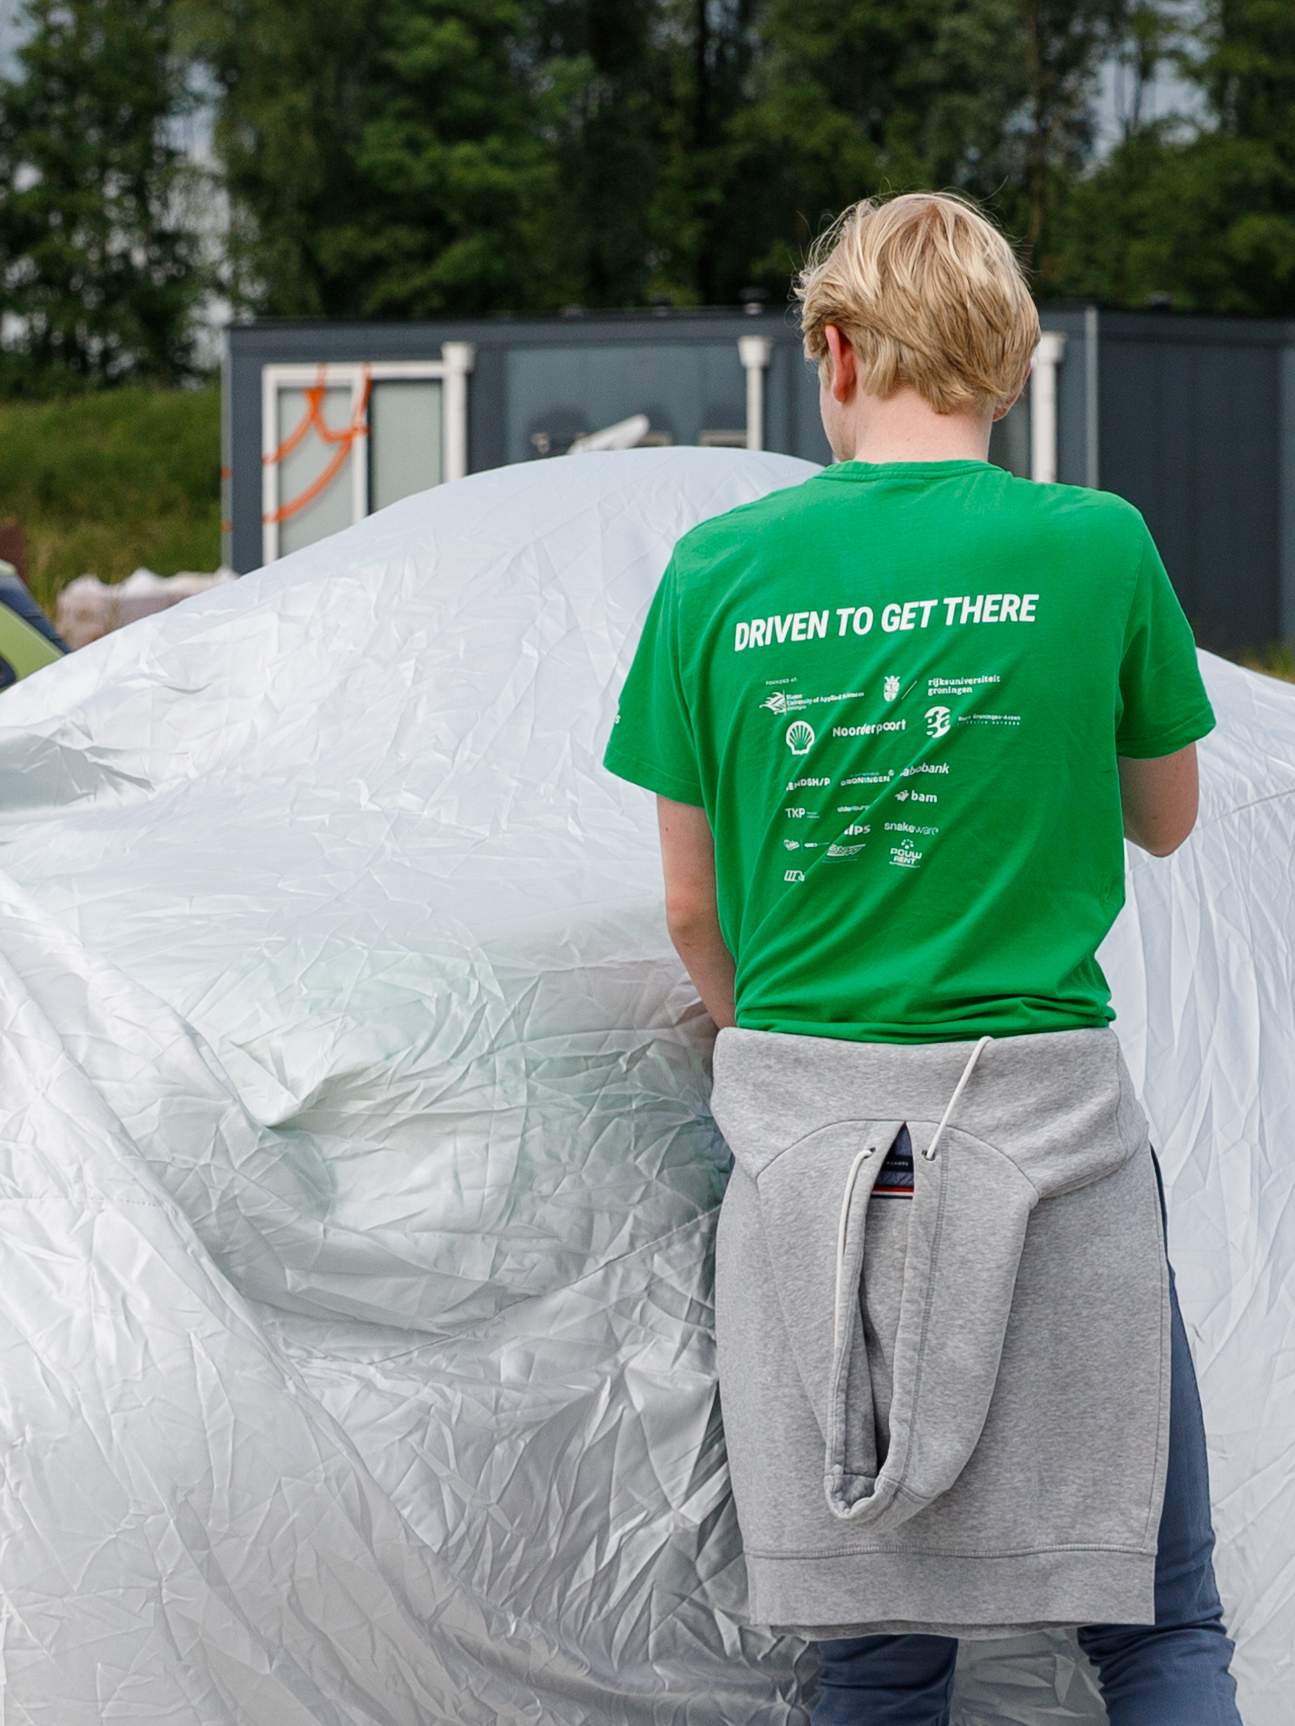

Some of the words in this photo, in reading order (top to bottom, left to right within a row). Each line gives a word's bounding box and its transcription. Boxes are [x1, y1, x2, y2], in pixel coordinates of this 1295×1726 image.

[734, 610, 830, 652] DRIVEN
[836, 606, 874, 637] TO
[881, 598, 938, 633] GET
[942, 593, 1040, 626] THERE
[927, 674, 1001, 687] rijksuniversiteit
[927, 685, 973, 697] groningen
[832, 719, 906, 738] Noorderpoort
[900, 762, 950, 778] abobank
[911, 790, 937, 802] bam
[785, 808, 805, 818] TKP
[884, 822, 939, 835] snakeware
